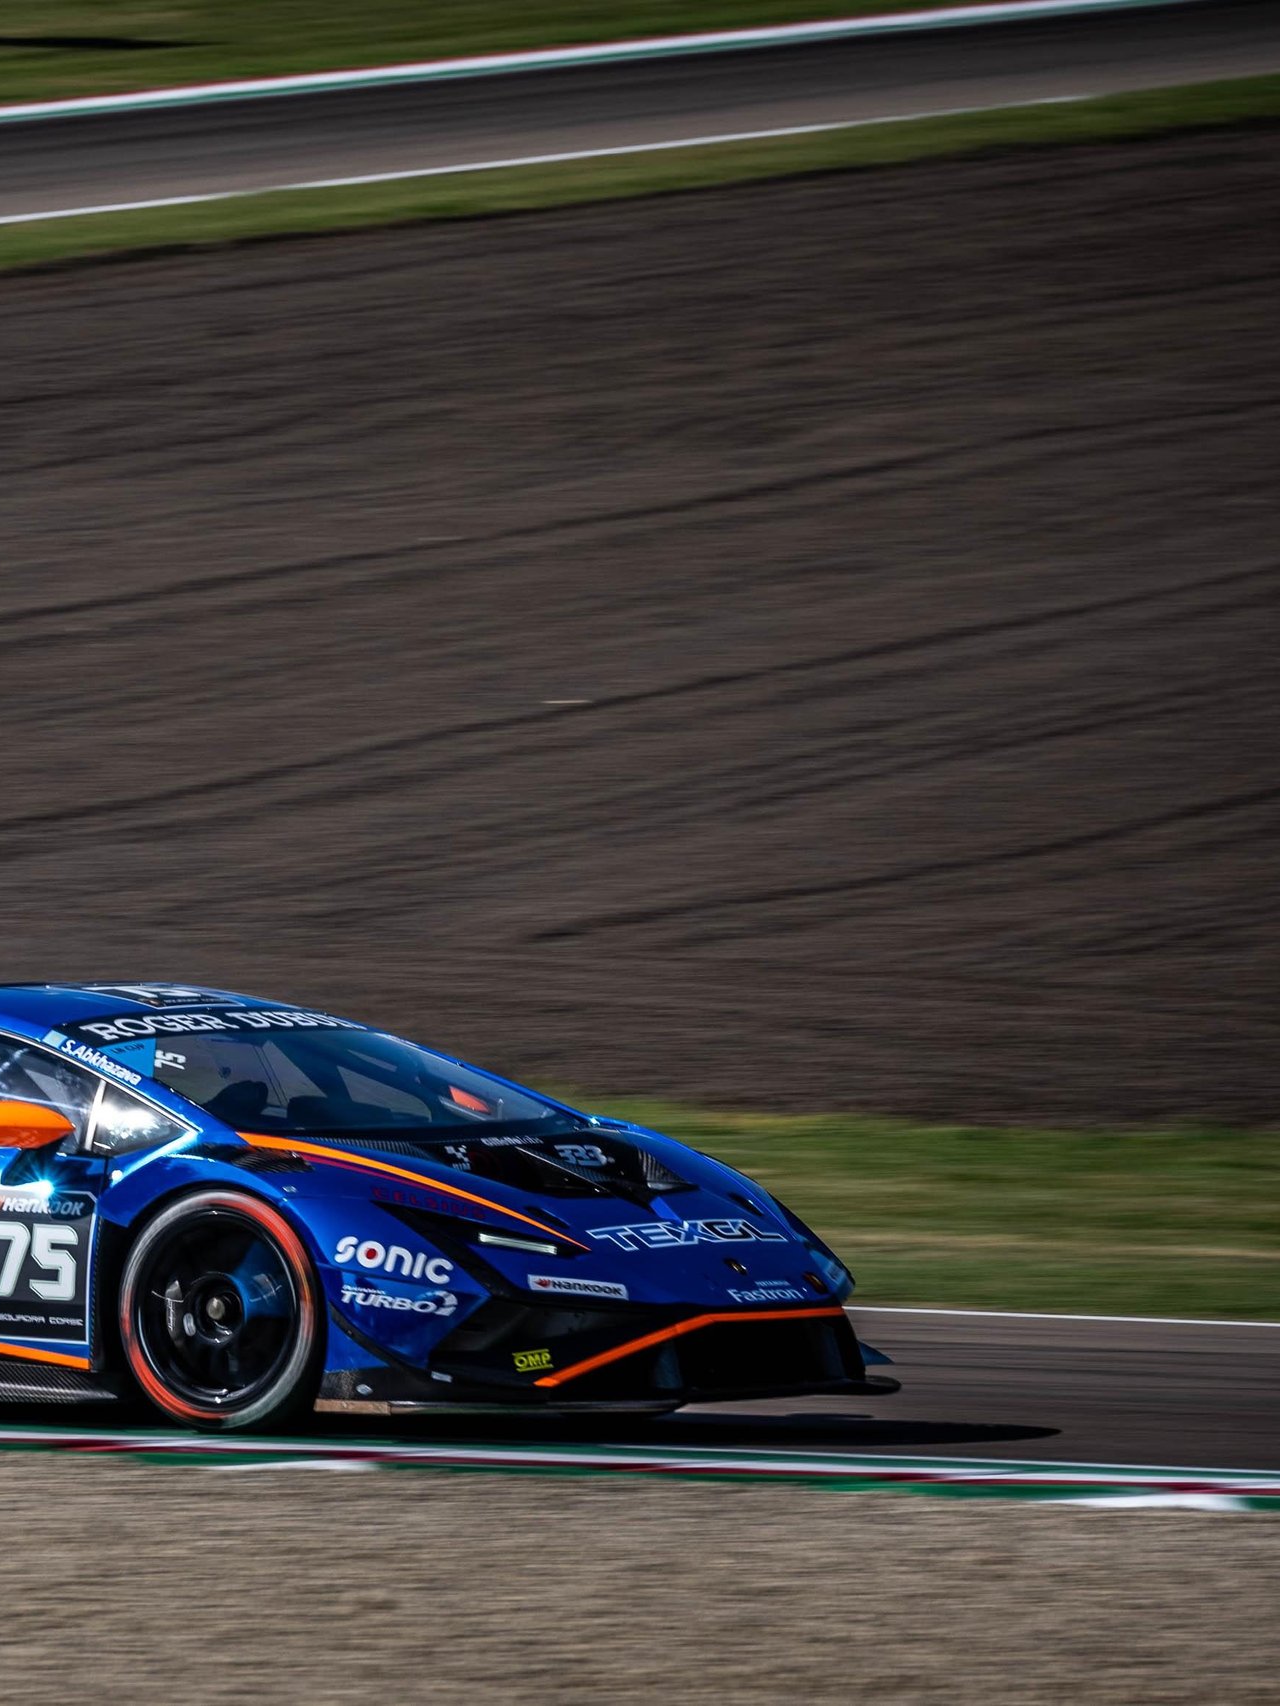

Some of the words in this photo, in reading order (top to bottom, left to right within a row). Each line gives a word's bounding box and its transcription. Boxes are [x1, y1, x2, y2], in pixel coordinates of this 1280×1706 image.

[79, 1014, 240, 1040] ROGER
[153, 1049, 187, 1070] 75
[726, 1287, 805, 1304] Fastron
[513, 1352, 552, 1368] OMP
